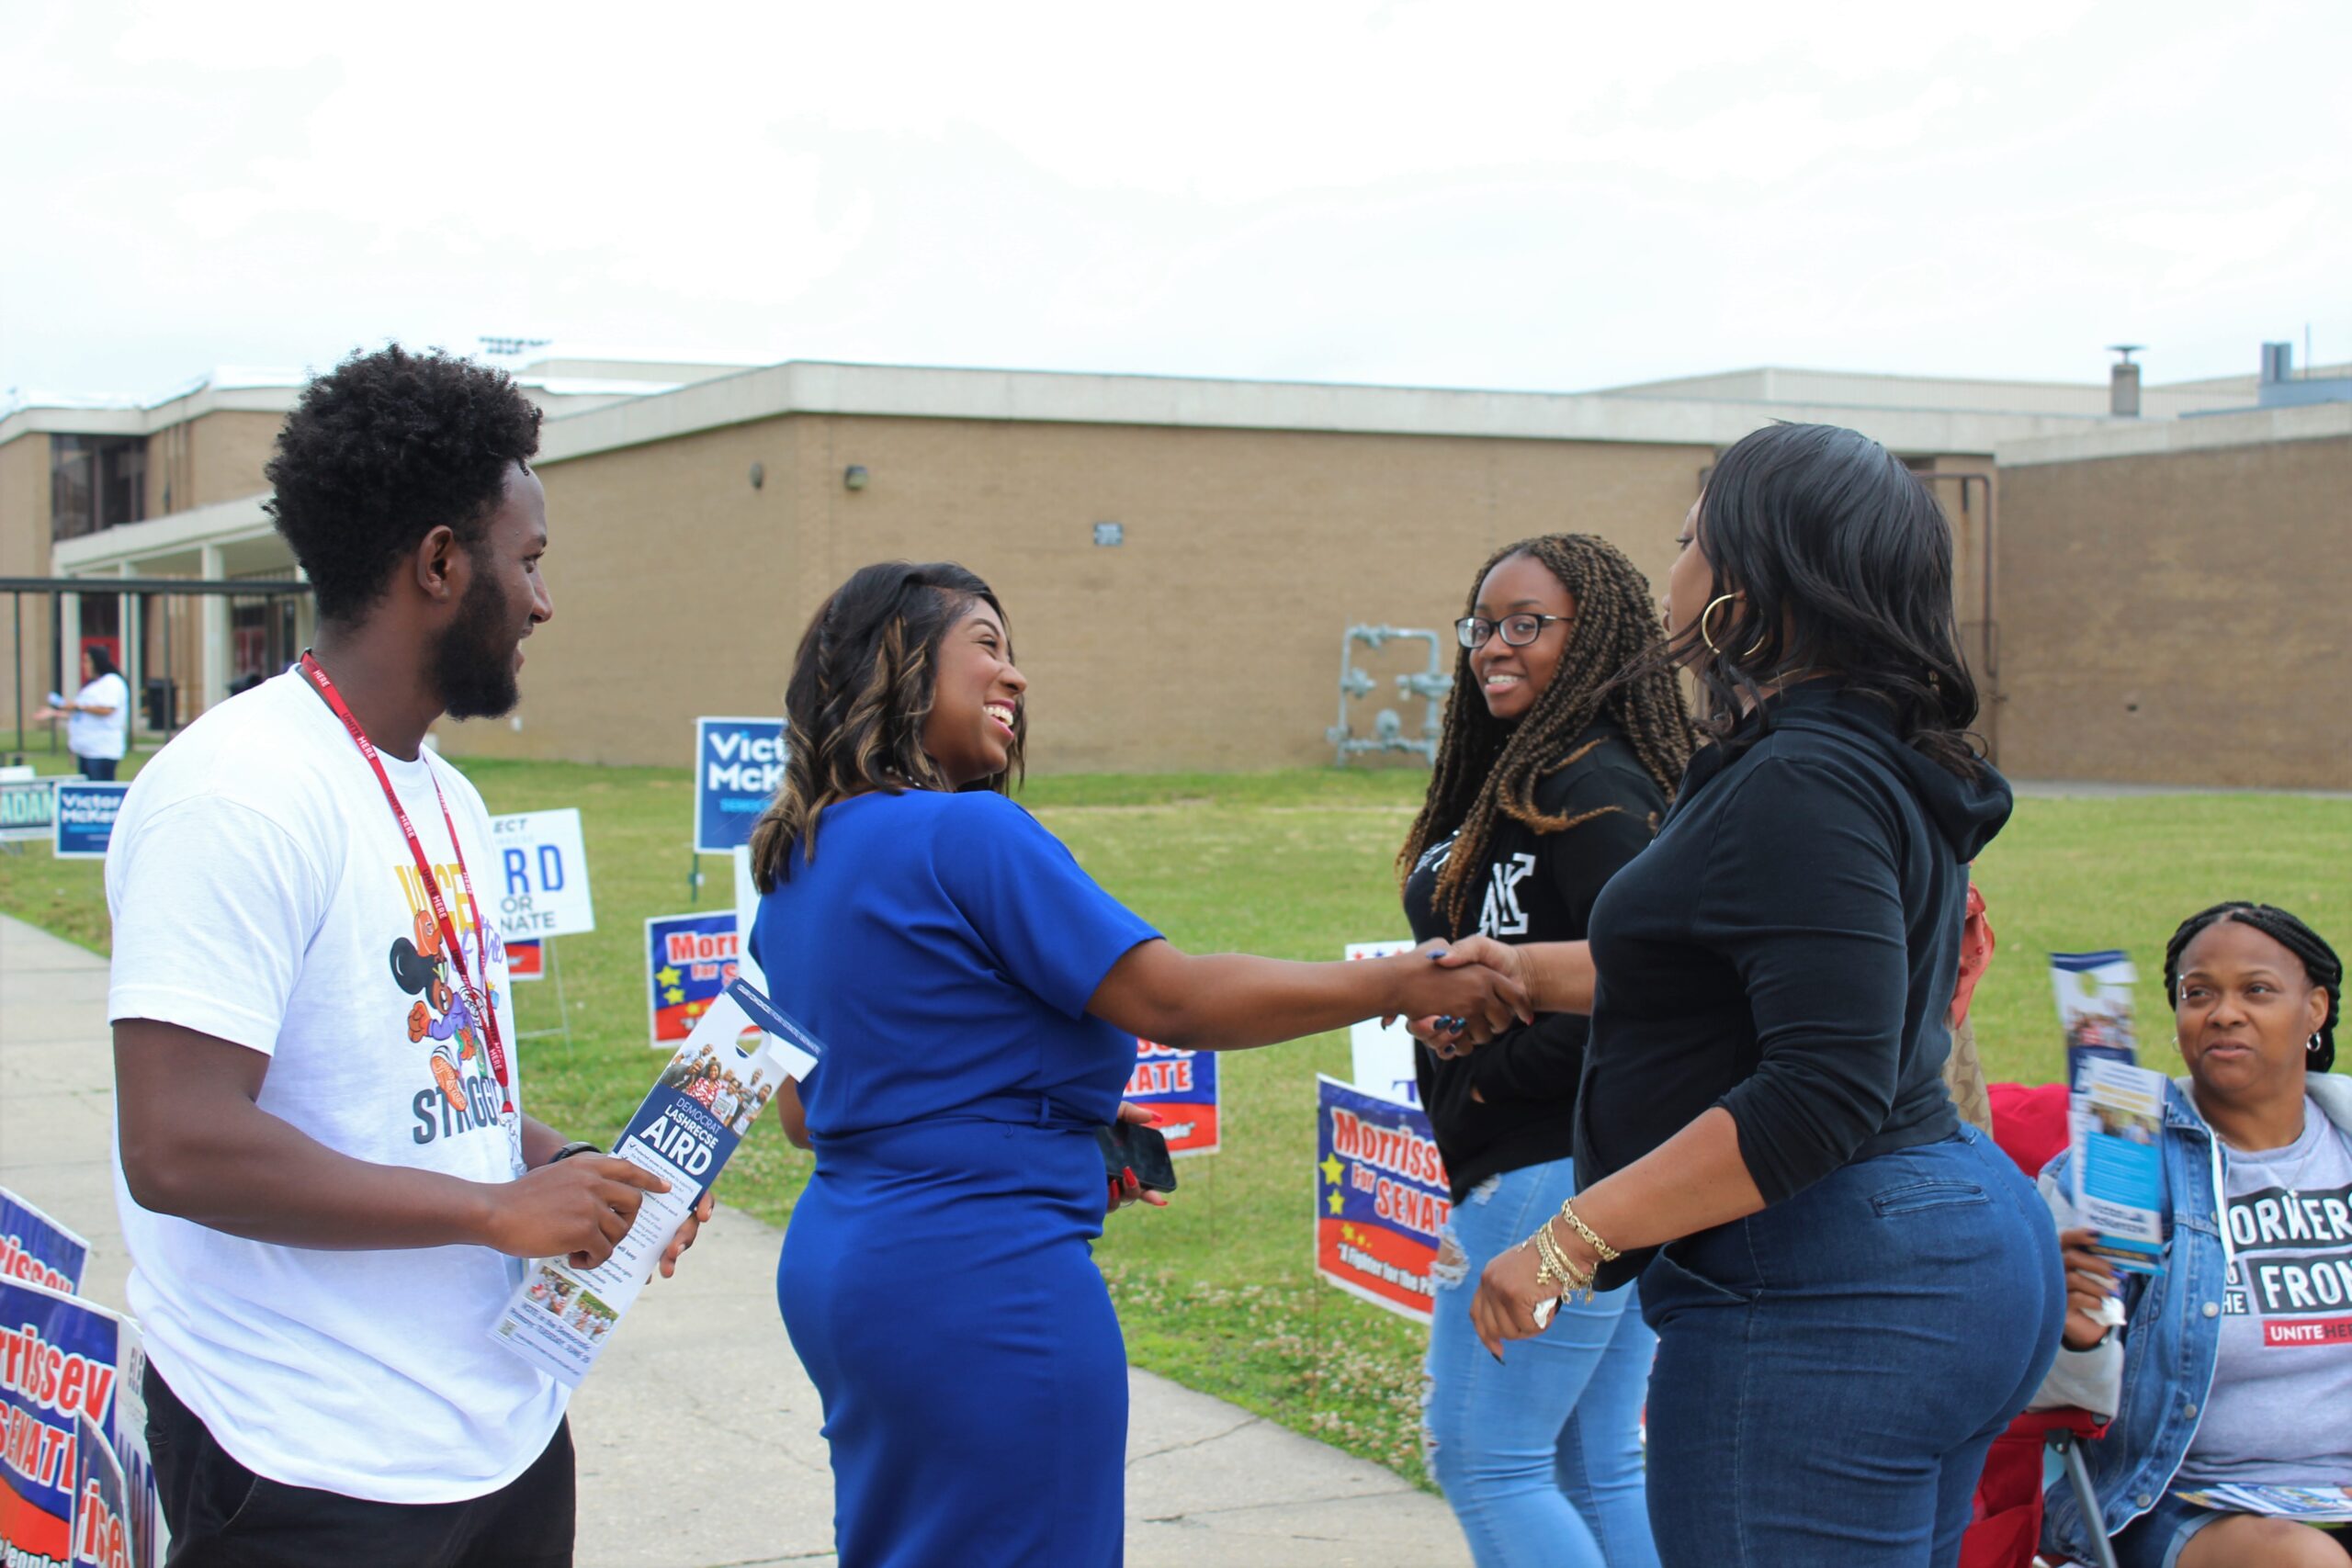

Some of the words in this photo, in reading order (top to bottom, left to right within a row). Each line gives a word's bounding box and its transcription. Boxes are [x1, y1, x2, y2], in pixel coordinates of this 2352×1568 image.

[356, 736, 377, 760] HERE
[433, 895, 448, 919] HERE
[664, 1104, 719, 1150] LASHRECSE
[676, 1097, 723, 1135] DEMOCRAT
[639, 1115, 713, 1176] AIRD
